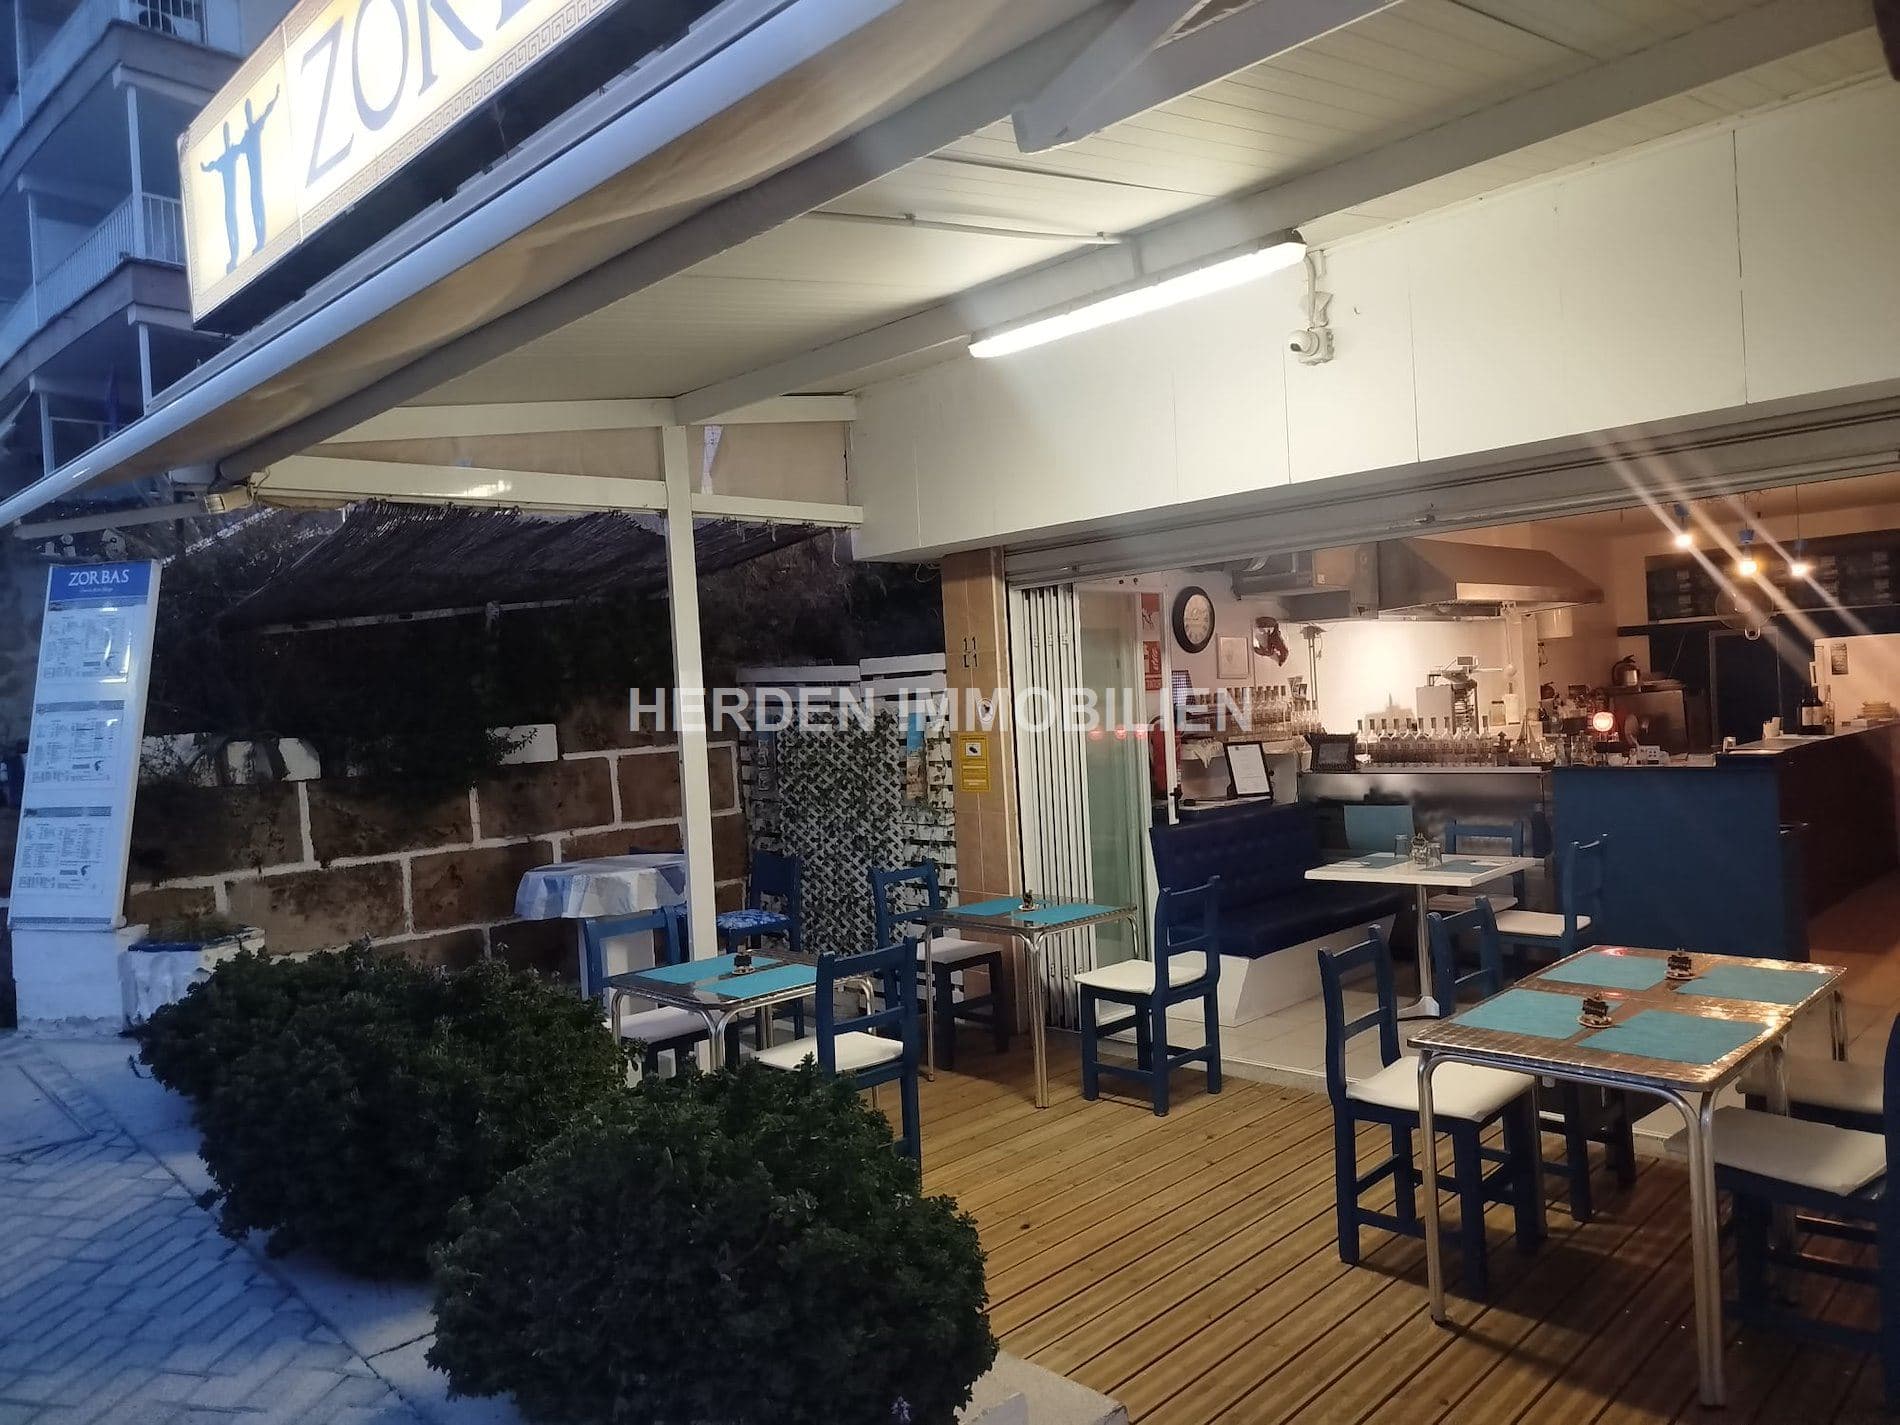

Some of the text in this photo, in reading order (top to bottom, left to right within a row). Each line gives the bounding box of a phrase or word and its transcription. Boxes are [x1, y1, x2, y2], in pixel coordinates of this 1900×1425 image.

[68, 569, 130, 586] ZORBAS
[963, 636, 977, 651] 11
[963, 653, 978, 668] L1
